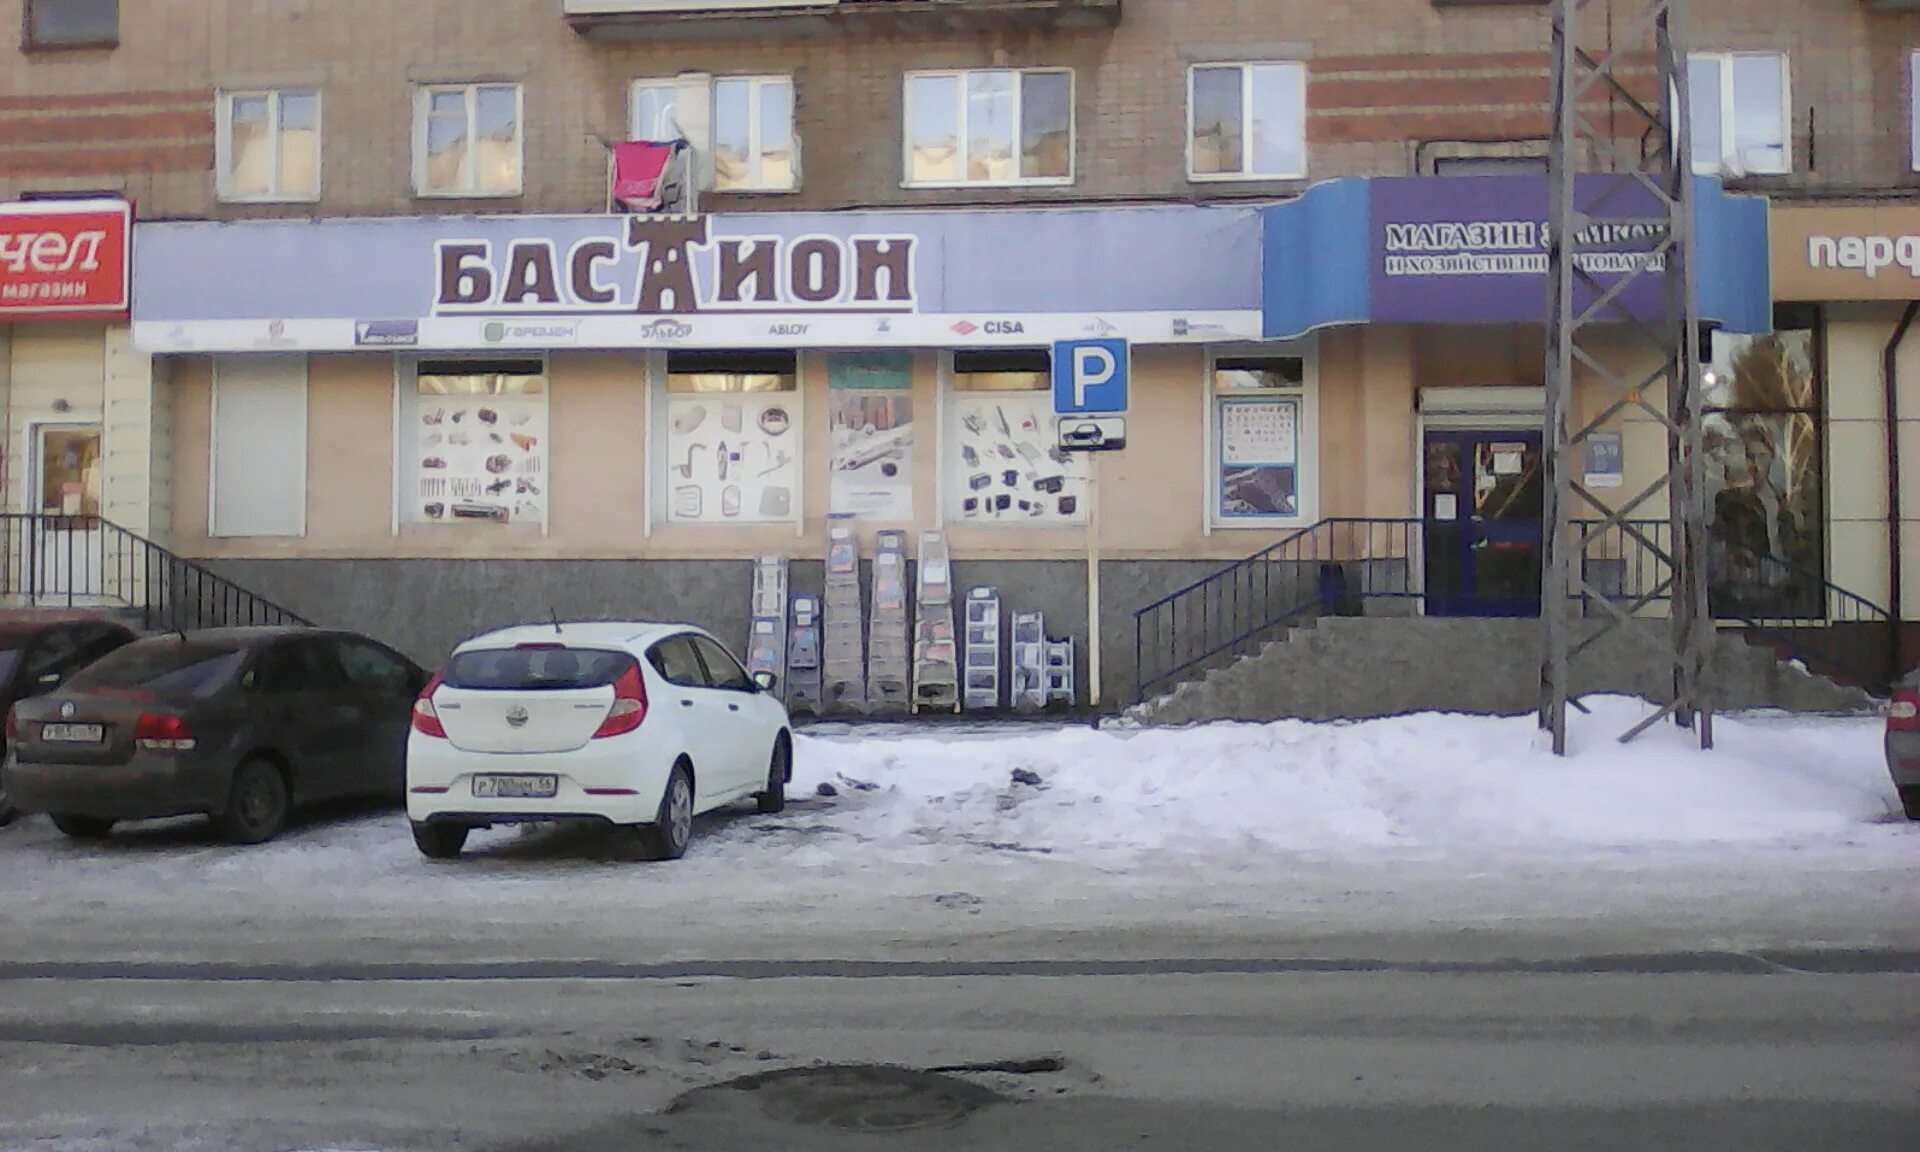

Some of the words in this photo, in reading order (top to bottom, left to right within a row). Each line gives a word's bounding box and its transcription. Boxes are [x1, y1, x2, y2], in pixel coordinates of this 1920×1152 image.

[1386, 223, 1535, 250] МАГАЗИН
[438, 215, 916, 312] БАСТИОН
[1405, 252, 1575, 273] ХОЗЯЙСТВЕНН
[2, 281, 87, 299] магазин
[768, 323, 811, 335] ABLOY
[983, 320, 1025, 334] CISA
